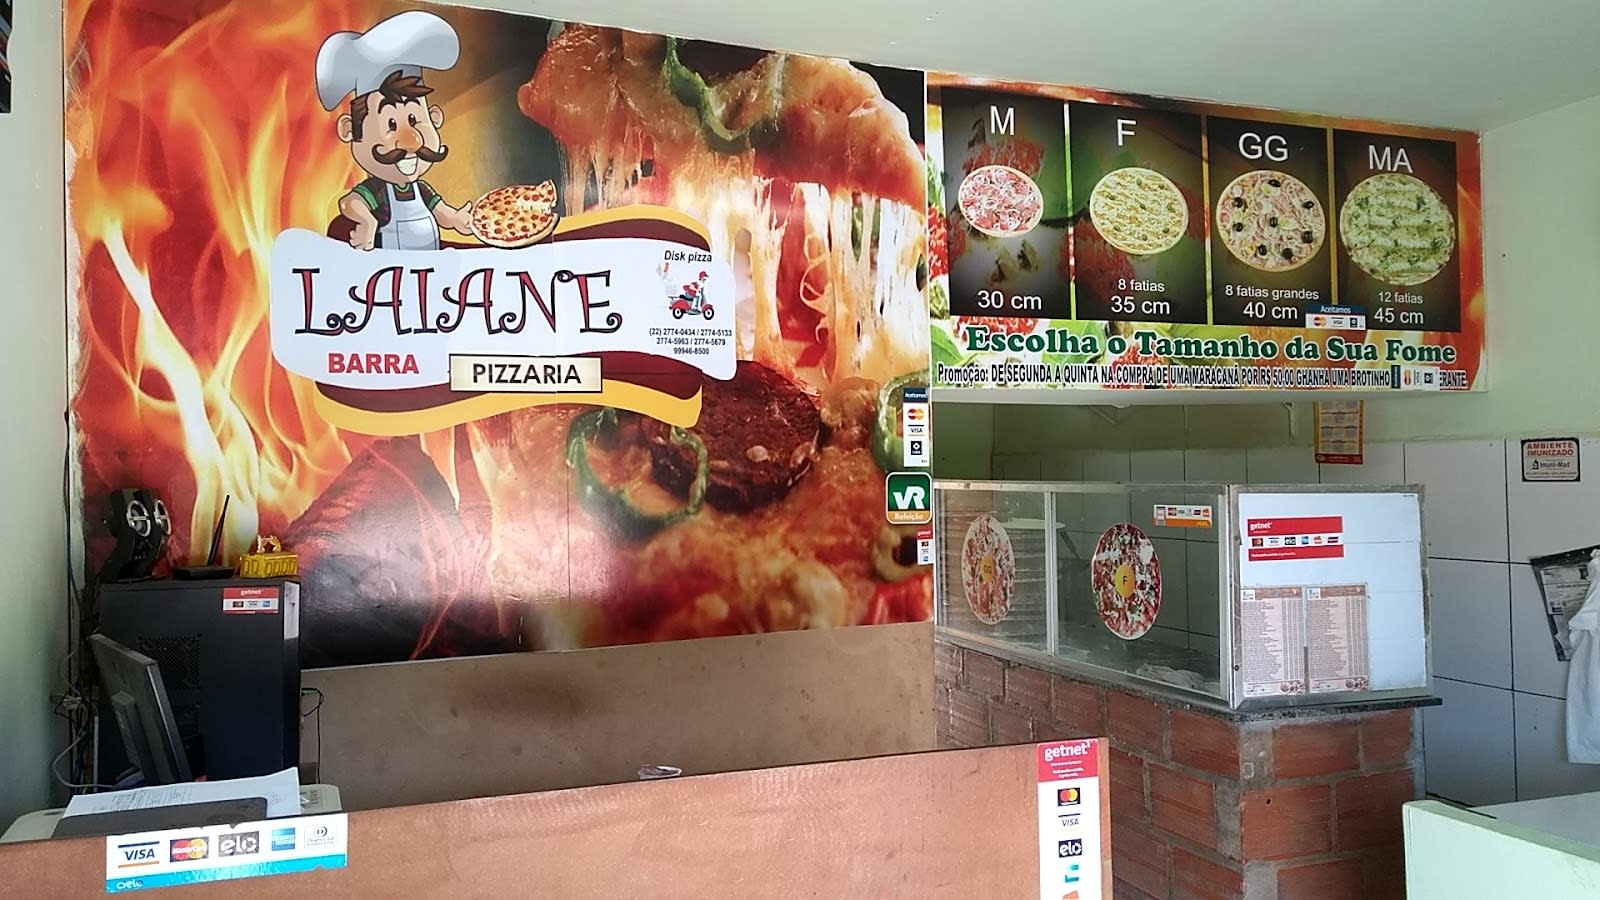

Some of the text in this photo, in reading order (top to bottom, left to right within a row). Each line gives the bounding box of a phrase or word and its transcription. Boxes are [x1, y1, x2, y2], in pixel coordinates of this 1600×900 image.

[990, 105, 1015, 136] M
[1116, 118, 1137, 146] F
[1238, 132, 1289, 162] GG
[1368, 144, 1413, 173] MA
[664, 250, 713, 264] Disk pizza
[1117, 279, 1166, 293] 8 fatias
[1225, 285, 1320, 301] 8 fatias grandes
[291, 265, 624, 336] LAIANE
[977, 290, 1042, 310] 30 cm
[1110, 295, 1170, 315] 35 cm
[1378, 291, 1424, 304] 12 fatias
[1243, 301, 1298, 320] 40 cm
[1320, 305, 1352, 314] Aceitamos
[1374, 307, 1424, 324] 45 cm
[648, 328, 662, 337] (22)
[663, 328, 696, 337] 2774-0434
[965, 326, 1456, 362] Escolha o Tamanho da Sua Fome
[327, 353, 420, 375] BARRA
[472, 362, 582, 385] PIZZARIA
[938, 364, 989, 387] Promoção:
[991, 364, 1004, 382] DE
[1006, 364, 1052, 383] SEGUNDA
[1054, 365, 1062, 383] A
[1063, 365, 1099, 385] QUINTA
[1101, 365, 1114, 384] NA
[1116, 365, 1154, 385] COMPRA
[1156, 366, 1168, 384] DE
[1170, 366, 1190, 385] UMA
[1241, 367, 1259, 386] POR
[1296, 368, 1331, 387] GHANHA
[1332, 369, 1349, 387] UMA
[1351, 369, 1391, 387] BROTINHO
[1527, 441, 1574, 450] AMBIENTE
[1527, 449, 1574, 457] IMUNIZADO
[894, 511, 924, 521] Refeição
[1250, 522, 1271, 531] getnet
[983, 565, 993, 574] GG
[1122, 575, 1128, 585] F
[1044, 742, 1089, 762] getnet
[1062, 818, 1079, 827] VISA
[220, 835, 258, 854] elo
[1059, 841, 1082, 856] elo
[125, 848, 156, 861] VISA
